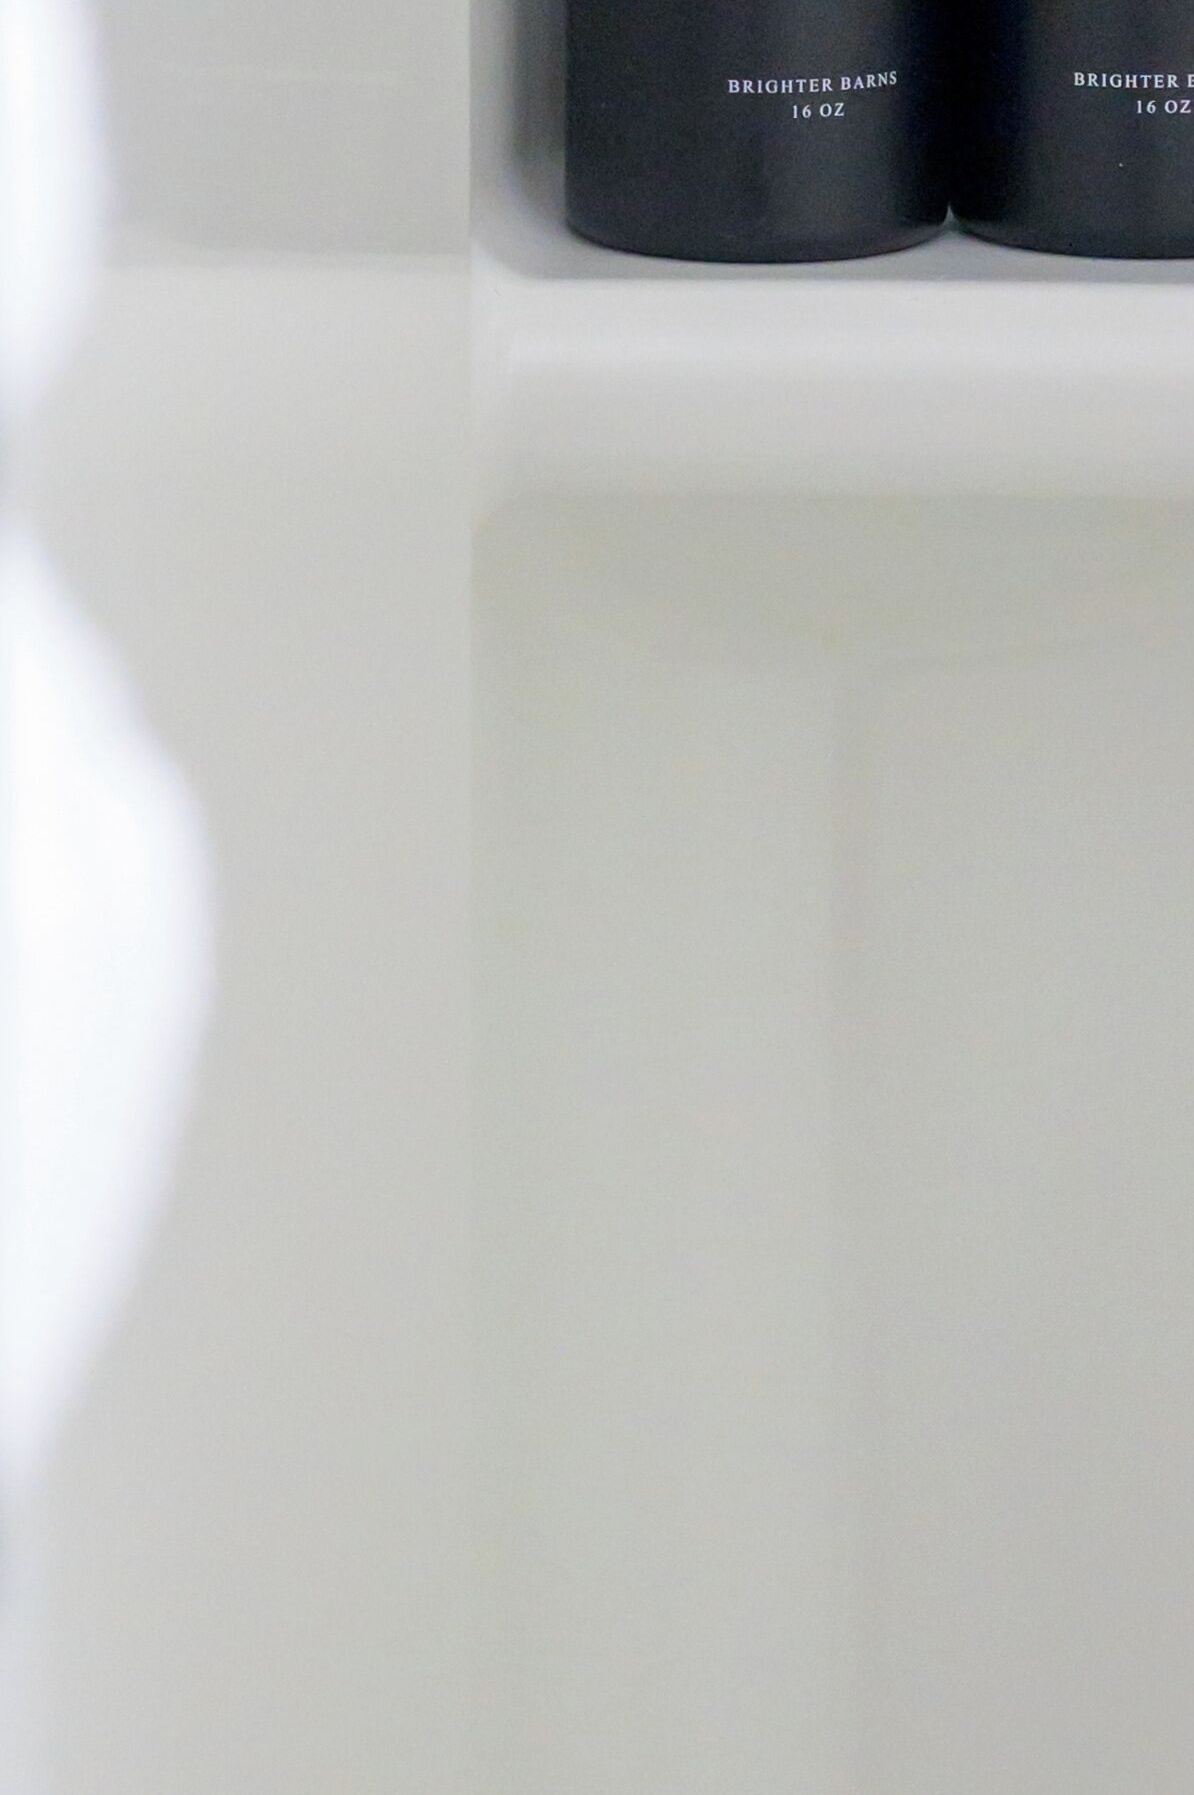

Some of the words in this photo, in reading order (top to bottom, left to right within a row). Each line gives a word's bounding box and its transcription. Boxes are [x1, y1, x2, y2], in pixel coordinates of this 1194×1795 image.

[727, 77, 833, 94] BRIGHTER
[840, 70, 898, 91] BARNS
[1074, 71, 1180, 89] BRIGHTER
[792, 104, 812, 119] 16
[819, 102, 845, 118] OZ
[1137, 100, 1157, 114] 16
[1164, 99, 1192, 114] OZ
